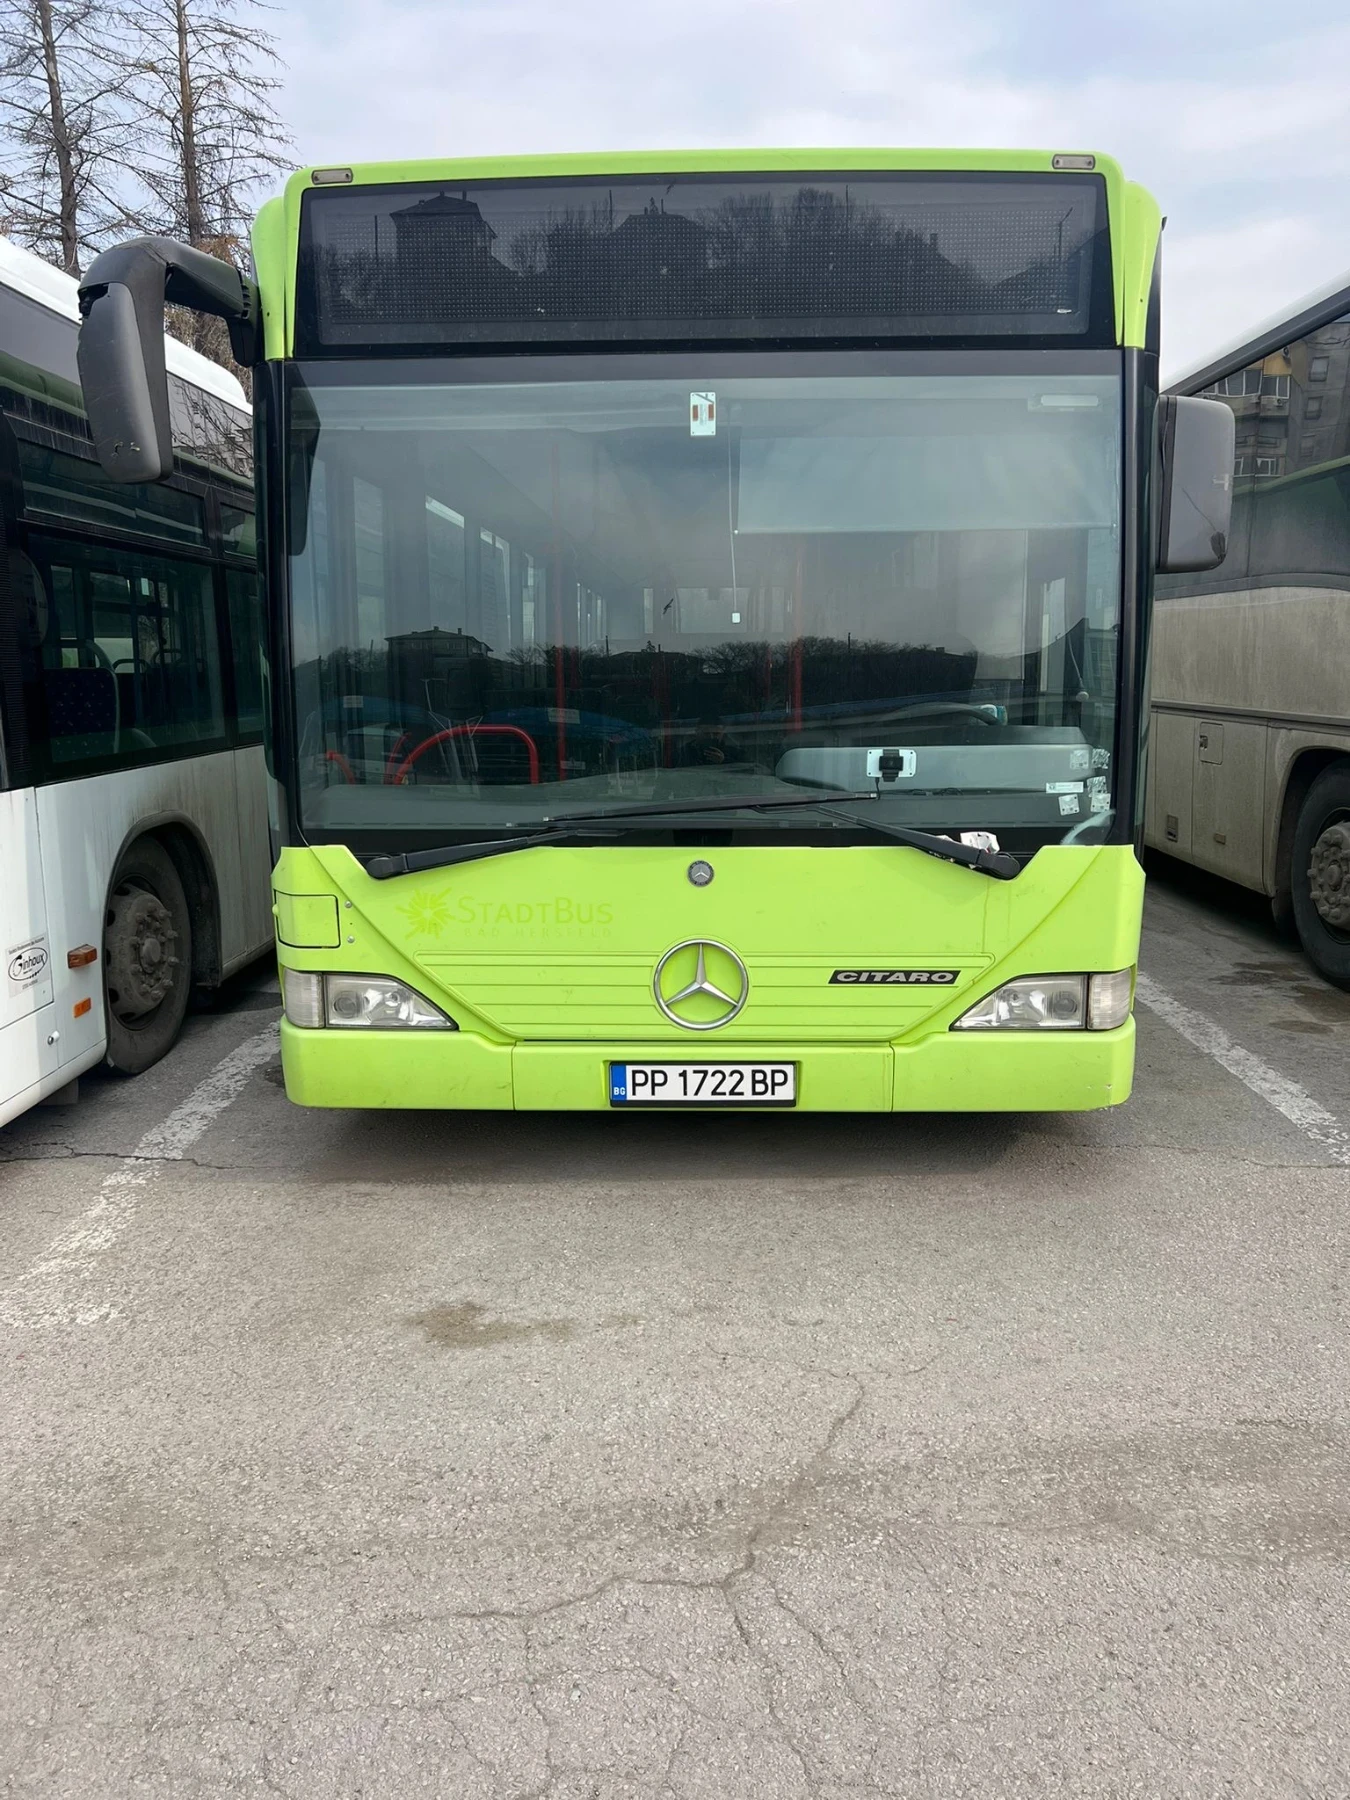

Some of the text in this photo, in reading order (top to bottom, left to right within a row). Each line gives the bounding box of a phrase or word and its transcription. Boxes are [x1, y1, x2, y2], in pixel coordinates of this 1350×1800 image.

[464, 926, 612, 938] BAD HERSFELD
[836, 971, 954, 982] CITARO
[631, 1069, 788, 1096] PP 1722 BP
[613, 1087, 626, 1096] BG
